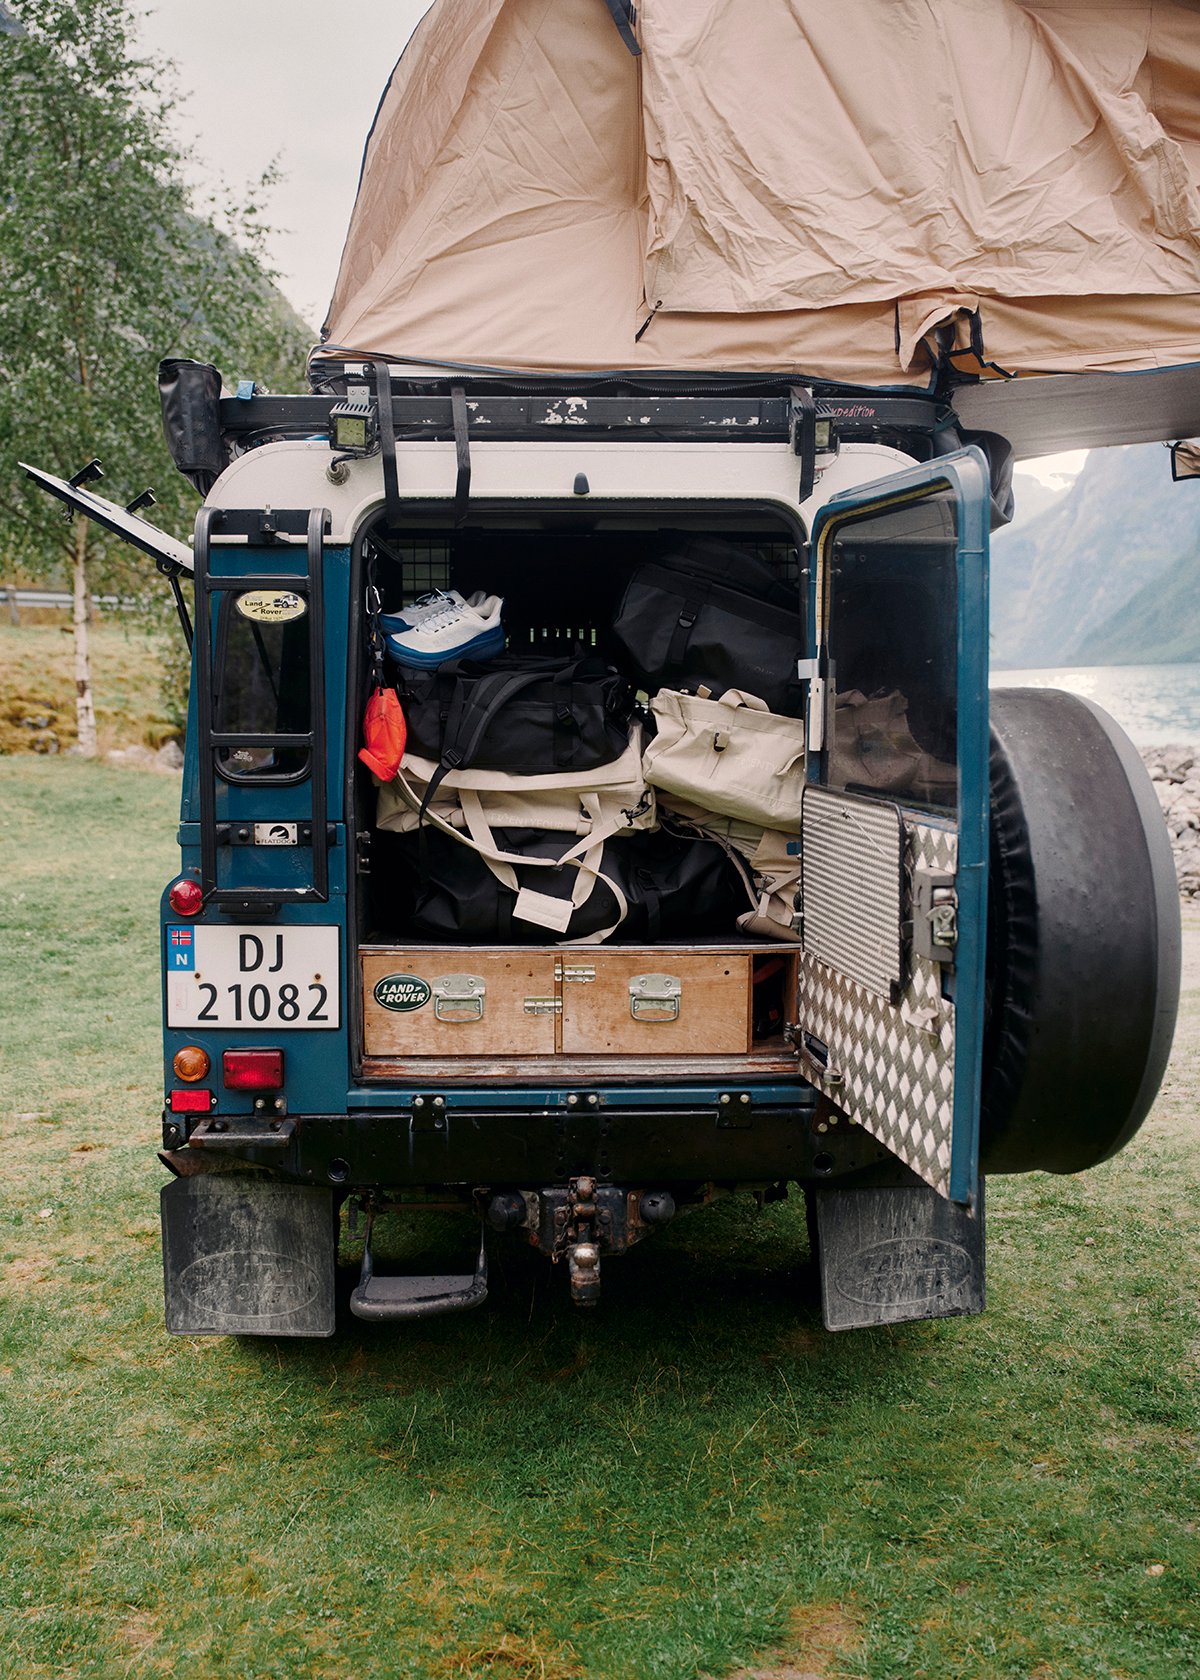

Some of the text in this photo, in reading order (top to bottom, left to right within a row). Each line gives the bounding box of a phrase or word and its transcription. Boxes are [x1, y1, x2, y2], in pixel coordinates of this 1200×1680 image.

[175, 953, 188, 966] N
[239, 933, 284, 973] DJ
[382, 983, 415, 994] LAND
[197, 982, 329, 1022] 21082
[386, 992, 426, 1003] ROVER
